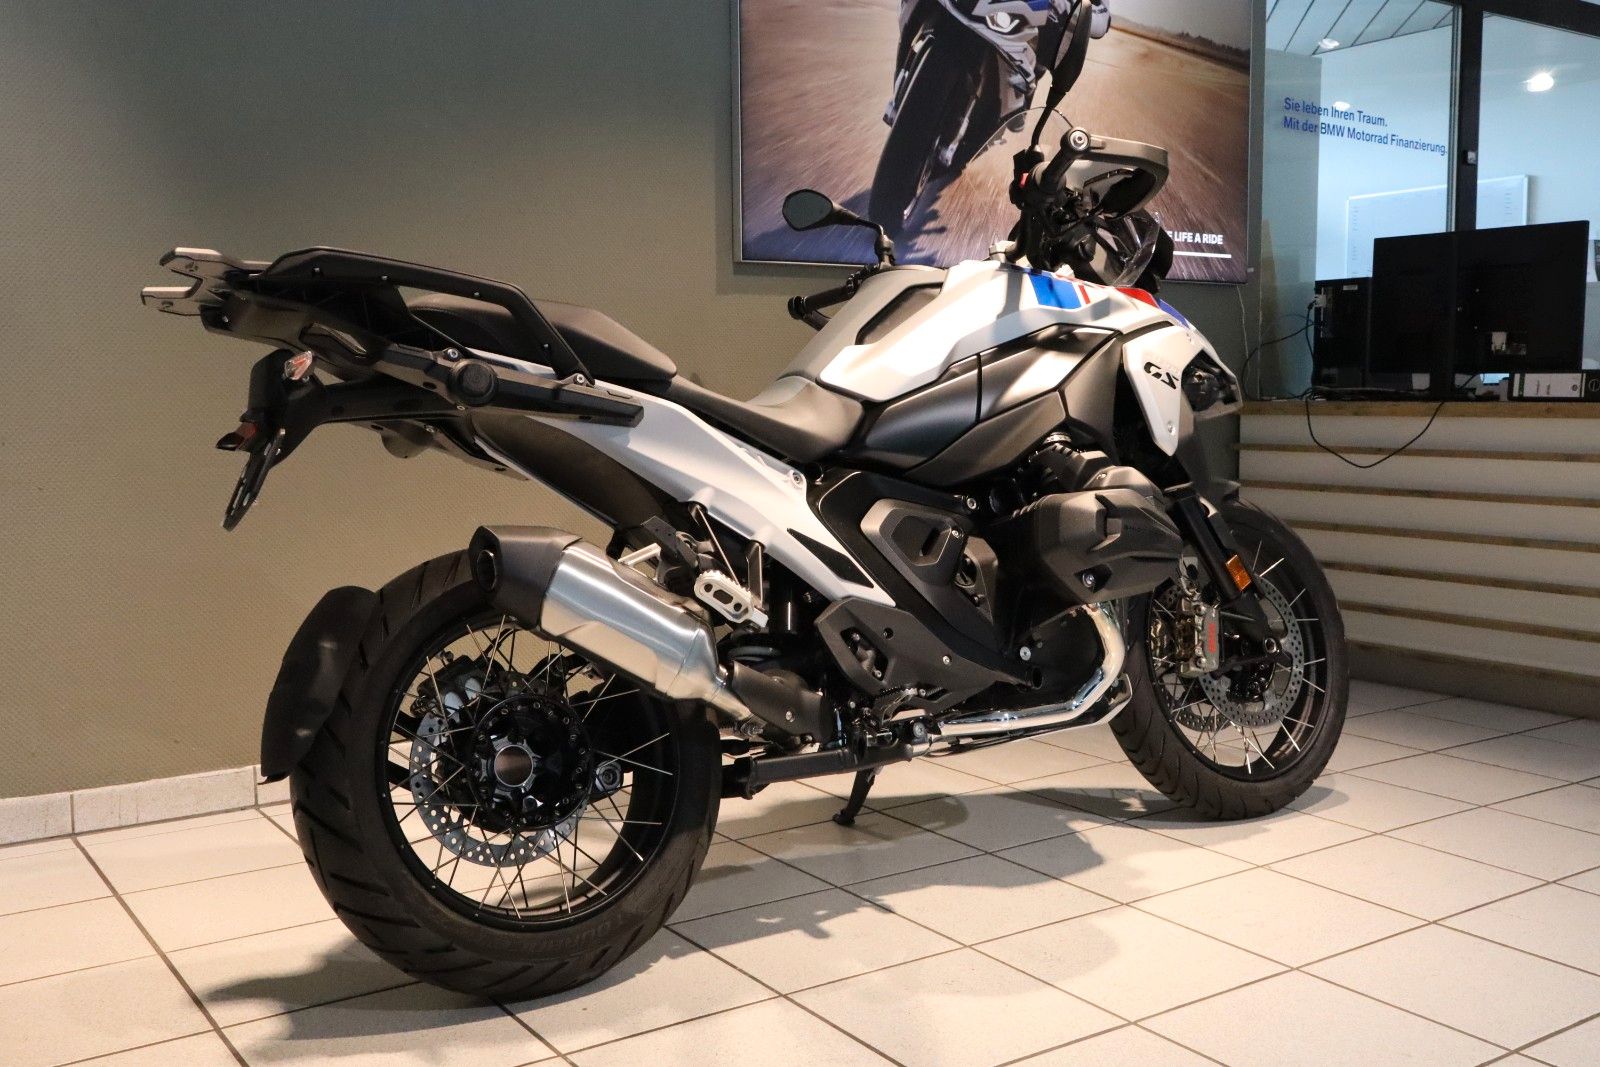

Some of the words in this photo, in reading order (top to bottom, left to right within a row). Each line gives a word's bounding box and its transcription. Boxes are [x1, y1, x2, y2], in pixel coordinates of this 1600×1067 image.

[1284, 97, 1300, 112] Sie
[1302, 101, 1328, 116] leben
[1331, 105, 1355, 121] Ihren
[1357, 111, 1388, 127] Traum.
[1283, 116, 1299, 130] Mit
[1301, 120, 1318, 133] der
[1320, 123, 1345, 138] BMW
[1347, 126, 1388, 145] Motorrad
[1390, 134, 1448, 156] Finanzierung.
[1174, 231, 1193, 243] LIFE
[1194, 232, 1201, 243] A
[1202, 233, 1223, 245] RIDE
[1143, 361, 1179, 390] GS
